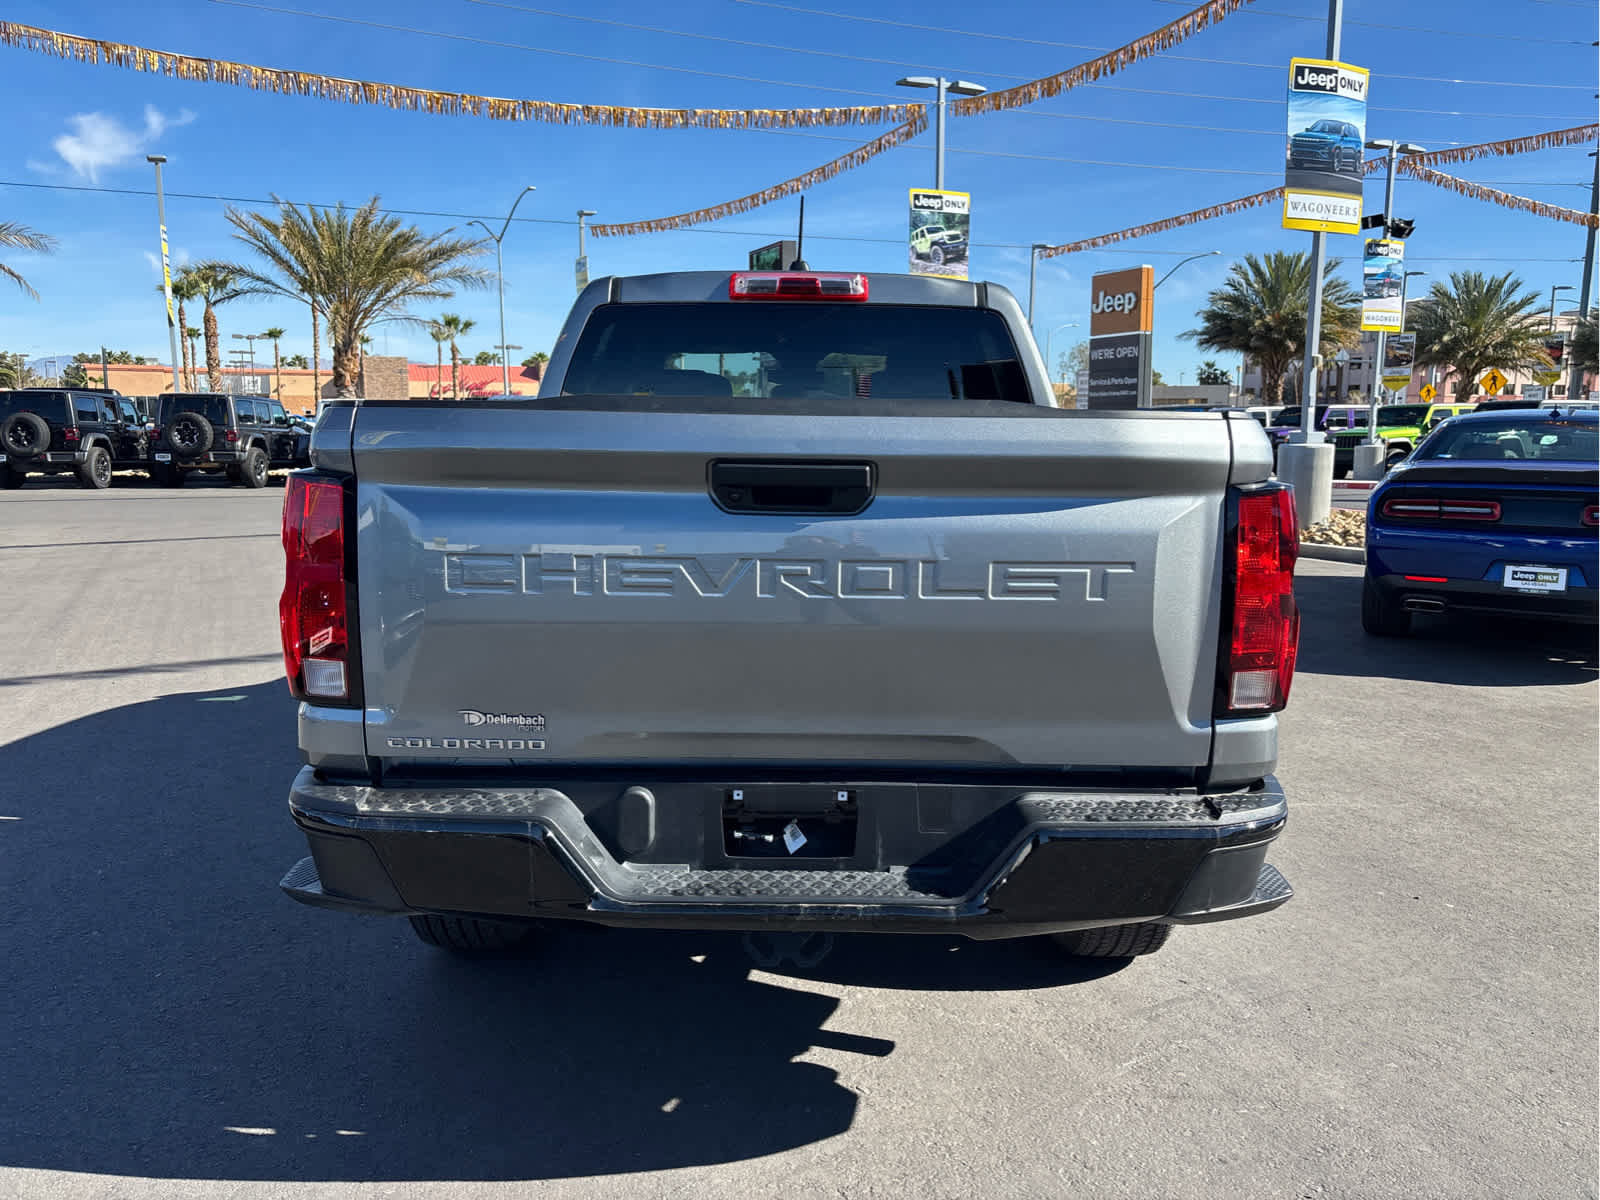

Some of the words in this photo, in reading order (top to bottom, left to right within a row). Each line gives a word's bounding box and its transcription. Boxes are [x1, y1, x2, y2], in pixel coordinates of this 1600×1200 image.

[1297, 68, 1336, 90] Jeep
[1339, 76, 1364, 93] ONLY
[915, 195, 942, 209] Jeep
[945, 200, 966, 208] ONLY
[1290, 201, 1358, 217] WAGONEERS
[1368, 244, 1389, 255] Jeep
[1092, 290, 1136, 313] Jeep
[1116, 346, 1138, 358] OPEN
[443, 553, 1137, 602] CHEVROLET
[1513, 571, 1535, 579] Jeep
[486, 714, 545, 726] Dellenbach
[386, 737, 546, 750] COLORADO
